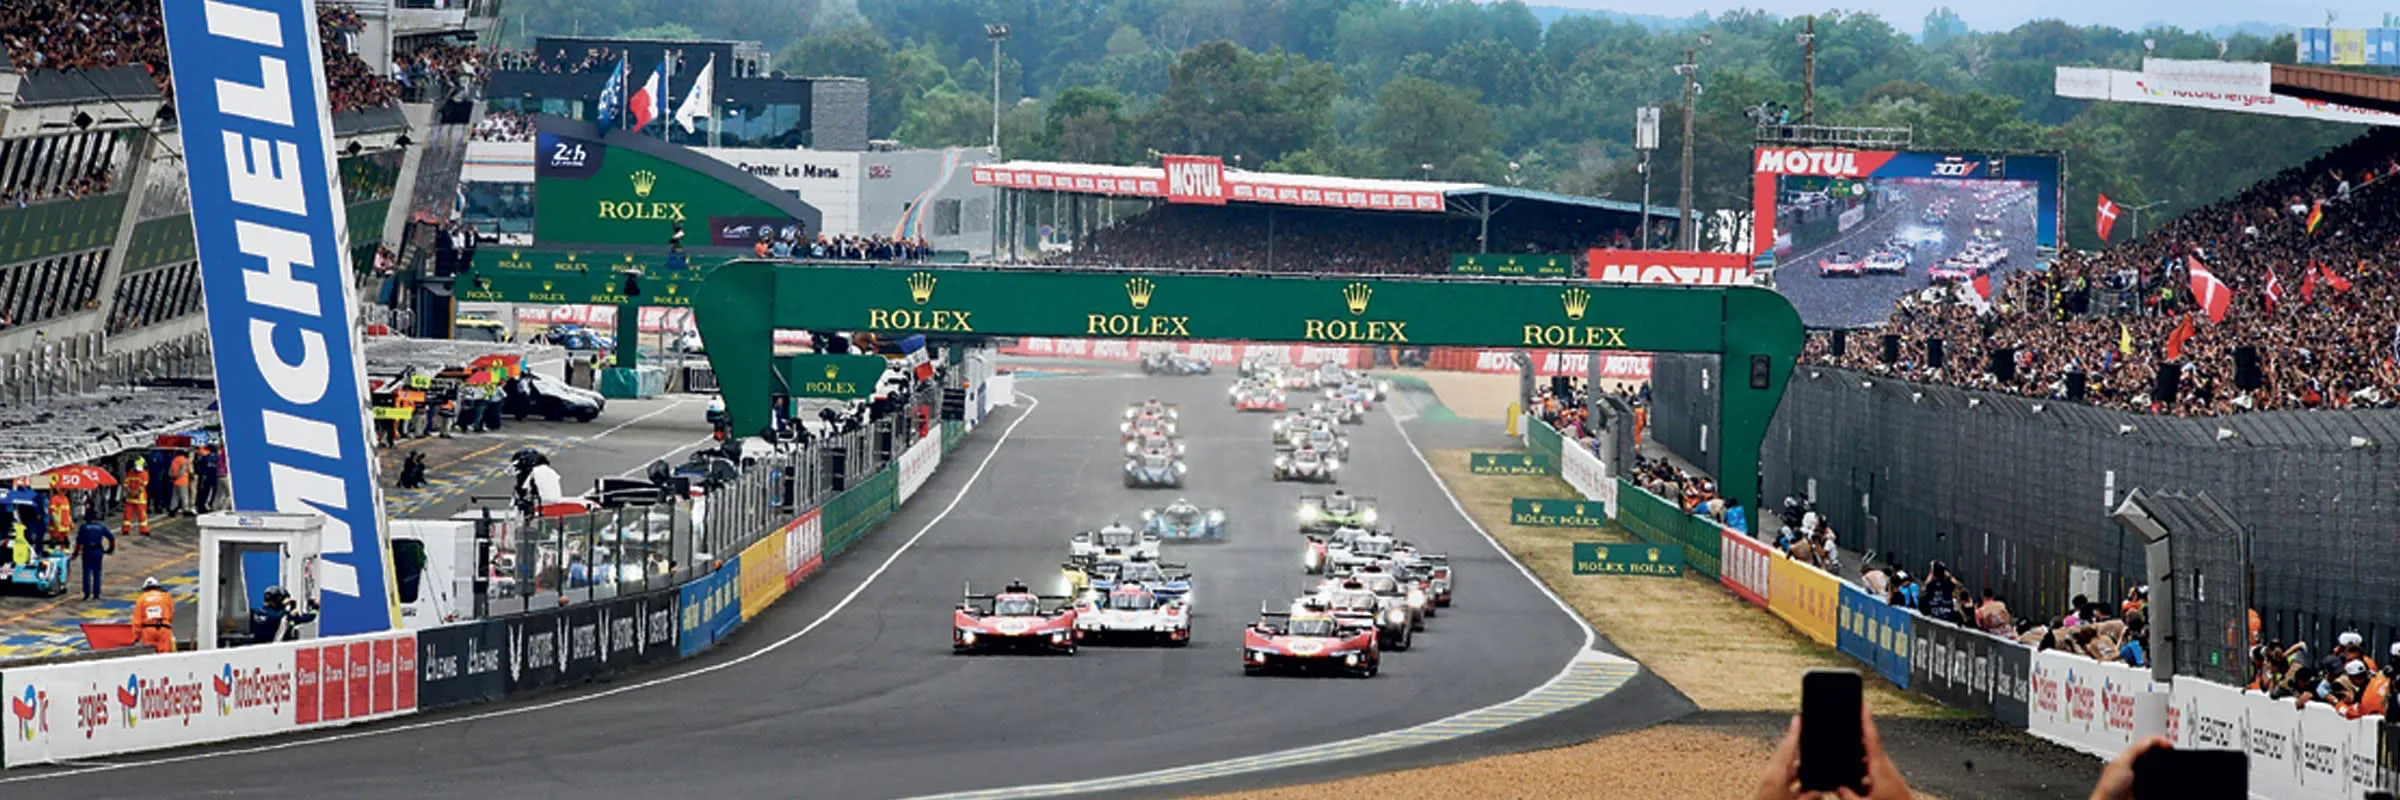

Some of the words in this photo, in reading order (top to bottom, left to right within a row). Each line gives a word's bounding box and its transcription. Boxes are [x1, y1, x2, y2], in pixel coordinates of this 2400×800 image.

[785, 164, 800, 177] Le
[803, 164, 840, 178] Mans
[1757, 151, 1858, 175] MOTUL
[1169, 163, 1222, 196] MOTUL
[599, 201, 686, 220] ROLEX
[868, 308, 973, 332] ROLEX
[1087, 314, 1190, 337] ROLEX
[1305, 319, 1408, 343] ROLEX
[1522, 325, 1627, 347] ROLEX
[806, 382, 857, 394] ROLEX
